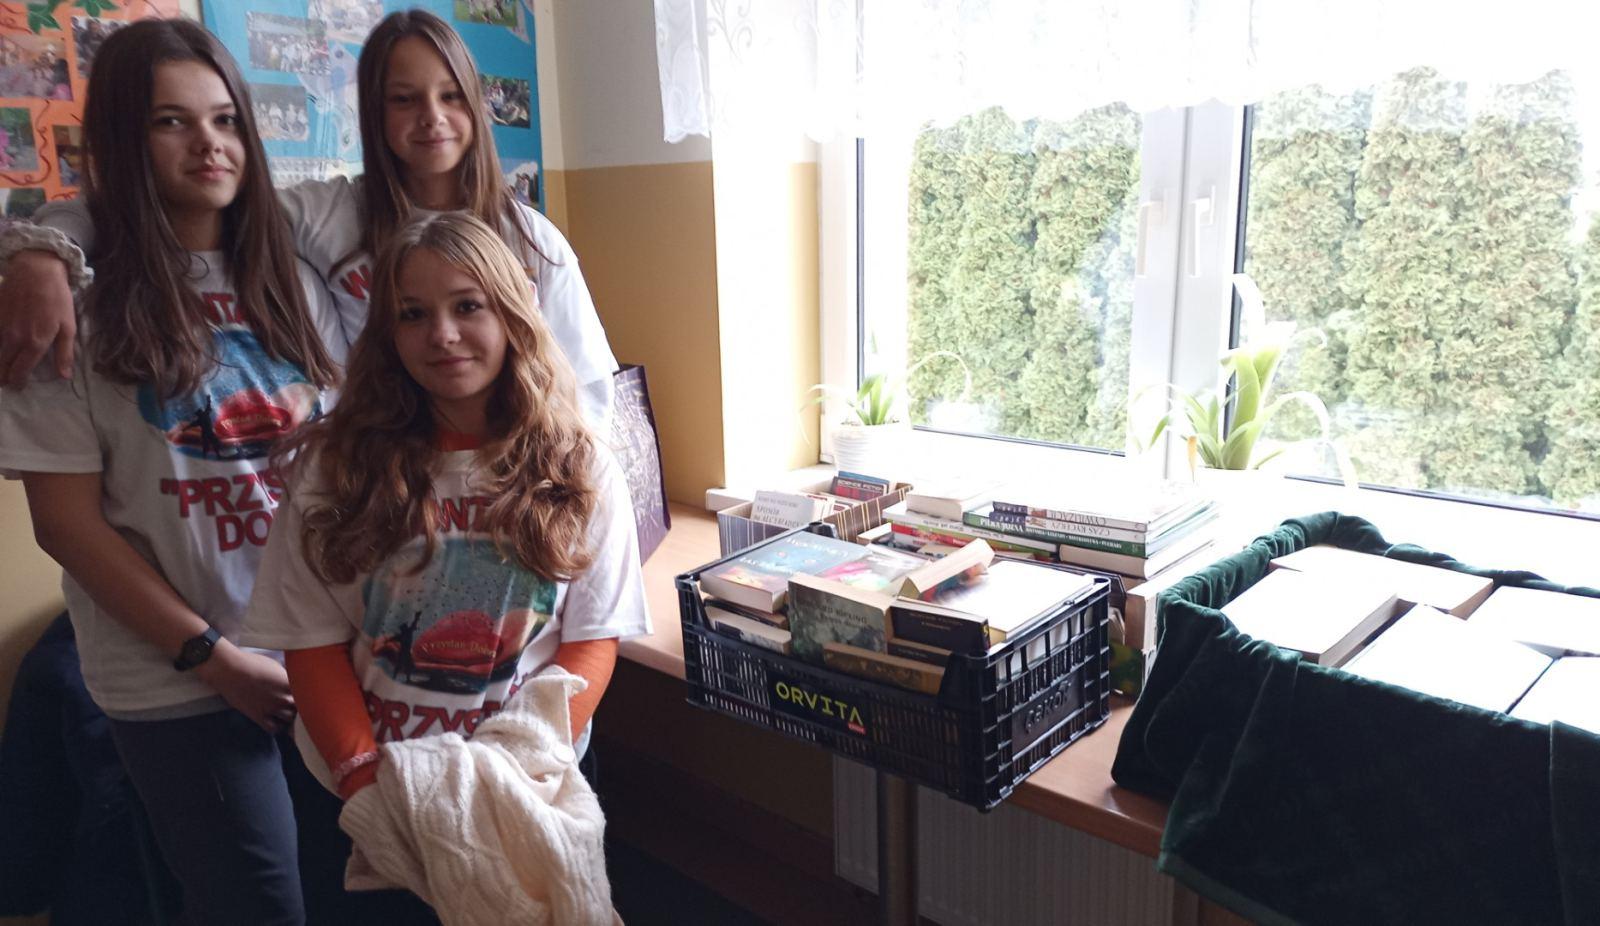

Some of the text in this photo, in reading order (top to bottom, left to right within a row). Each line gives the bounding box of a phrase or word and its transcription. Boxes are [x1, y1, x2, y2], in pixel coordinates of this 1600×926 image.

[1051, 521, 1110, 537] CZAS RYCERZY
[775, 681, 864, 727] ORVITA
